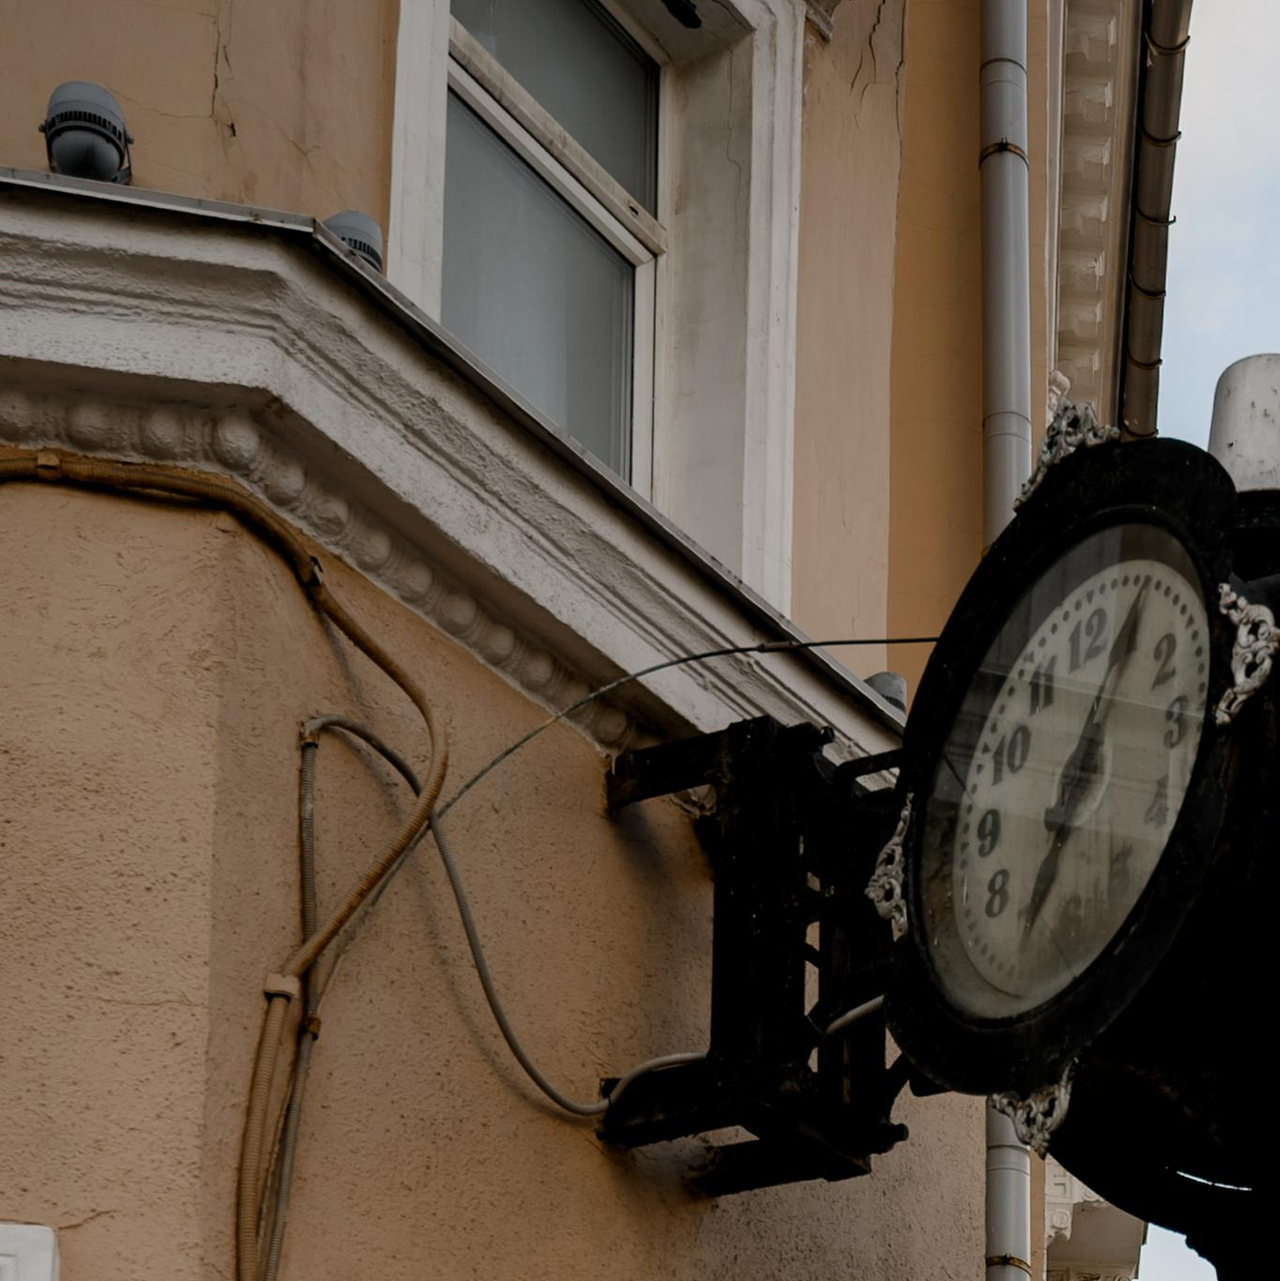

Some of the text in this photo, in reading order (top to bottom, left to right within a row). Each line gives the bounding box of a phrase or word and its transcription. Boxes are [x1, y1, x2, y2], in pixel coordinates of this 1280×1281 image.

[1068, 608, 1108, 674] 12
[1151, 632, 1178, 691] 2
[1028, 655, 1058, 718] 11
[1163, 694, 1190, 750] 3
[991, 723, 1032, 787] 10
[976, 808, 1002, 858] 9
[984, 868, 1011, 919] 8
